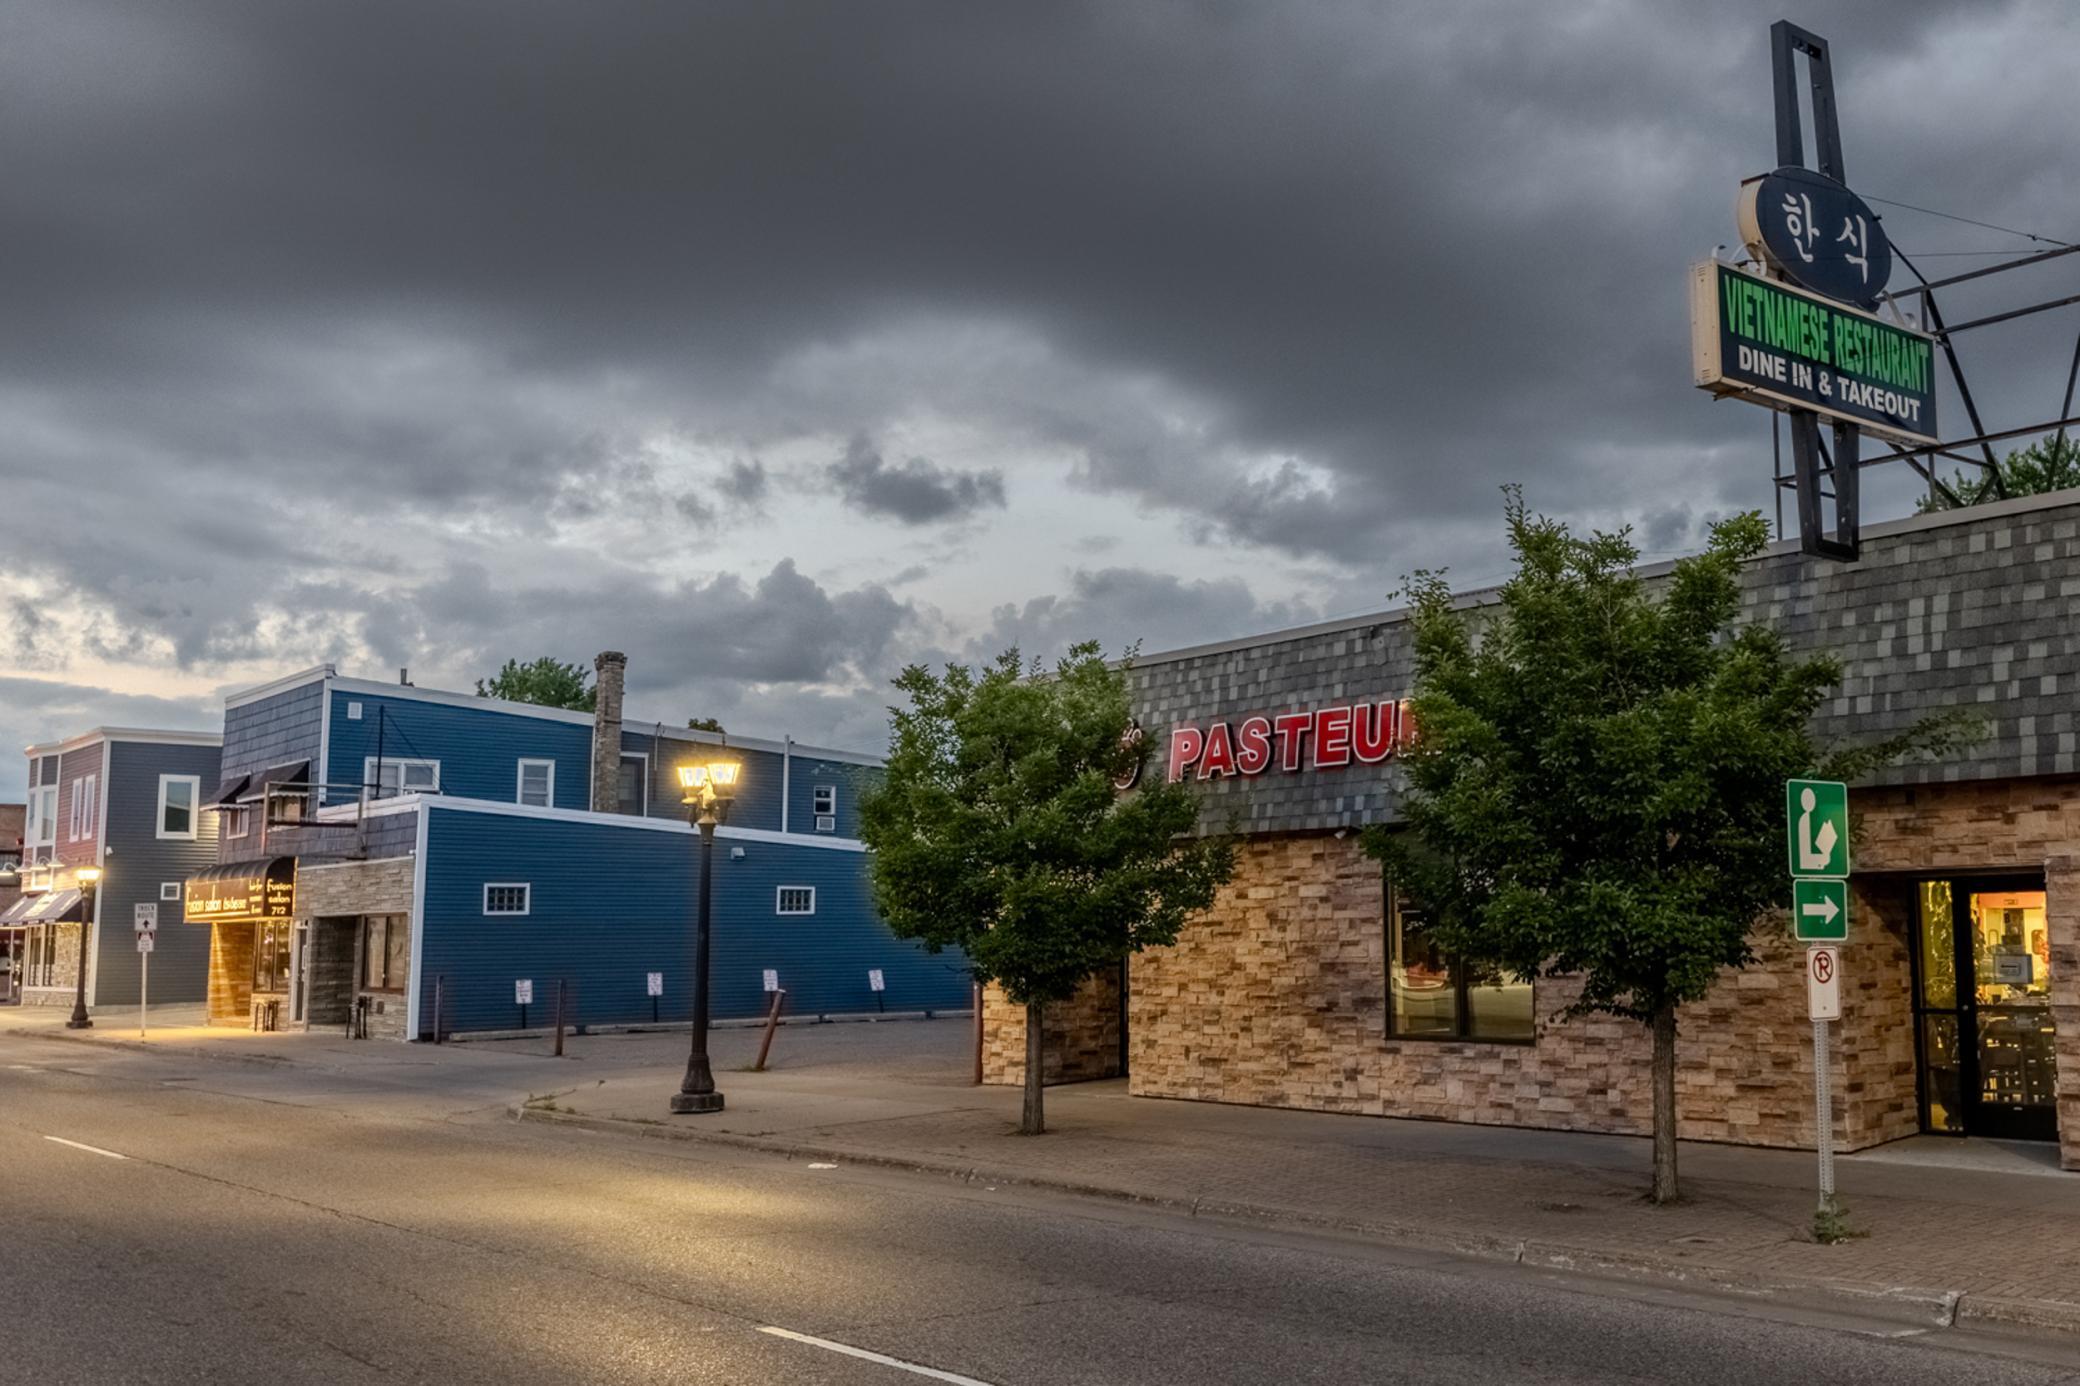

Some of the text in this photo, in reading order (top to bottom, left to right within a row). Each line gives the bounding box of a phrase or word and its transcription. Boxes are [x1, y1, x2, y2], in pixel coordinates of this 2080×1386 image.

[1782, 193, 1868, 284] 한식
[1724, 274, 1929, 394] VIETNAMESE RESTAURANT
[1738, 345, 1921, 422] DINE IN & TAKEOUT
